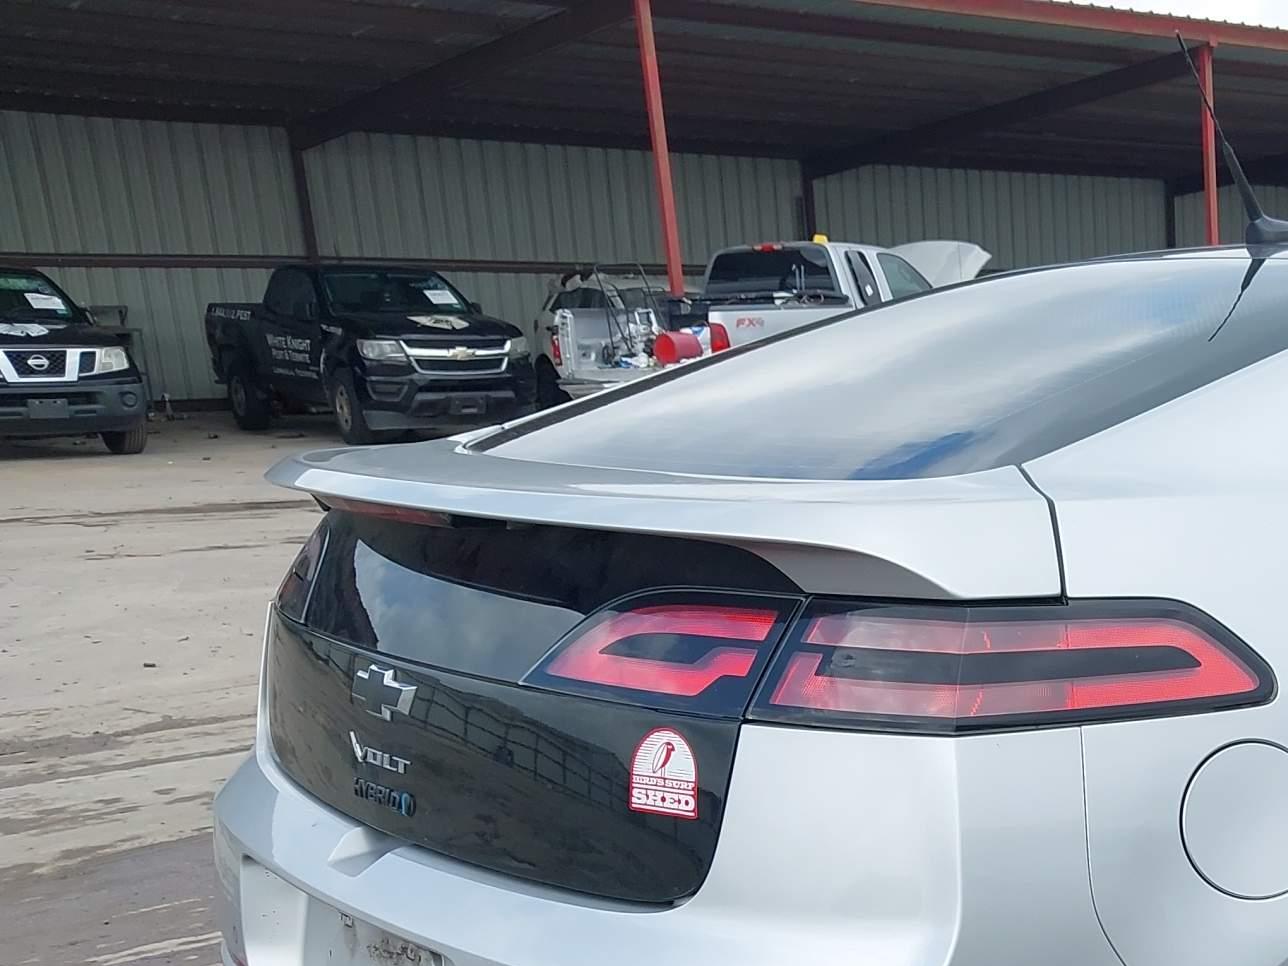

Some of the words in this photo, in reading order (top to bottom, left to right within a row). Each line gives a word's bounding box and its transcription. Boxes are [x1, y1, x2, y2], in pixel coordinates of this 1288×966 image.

[350, 730, 411, 774] VOLT
[353, 776, 400, 812] HYBRID
[665, 779, 695, 790] SURF
[632, 788, 695, 811] SHED
